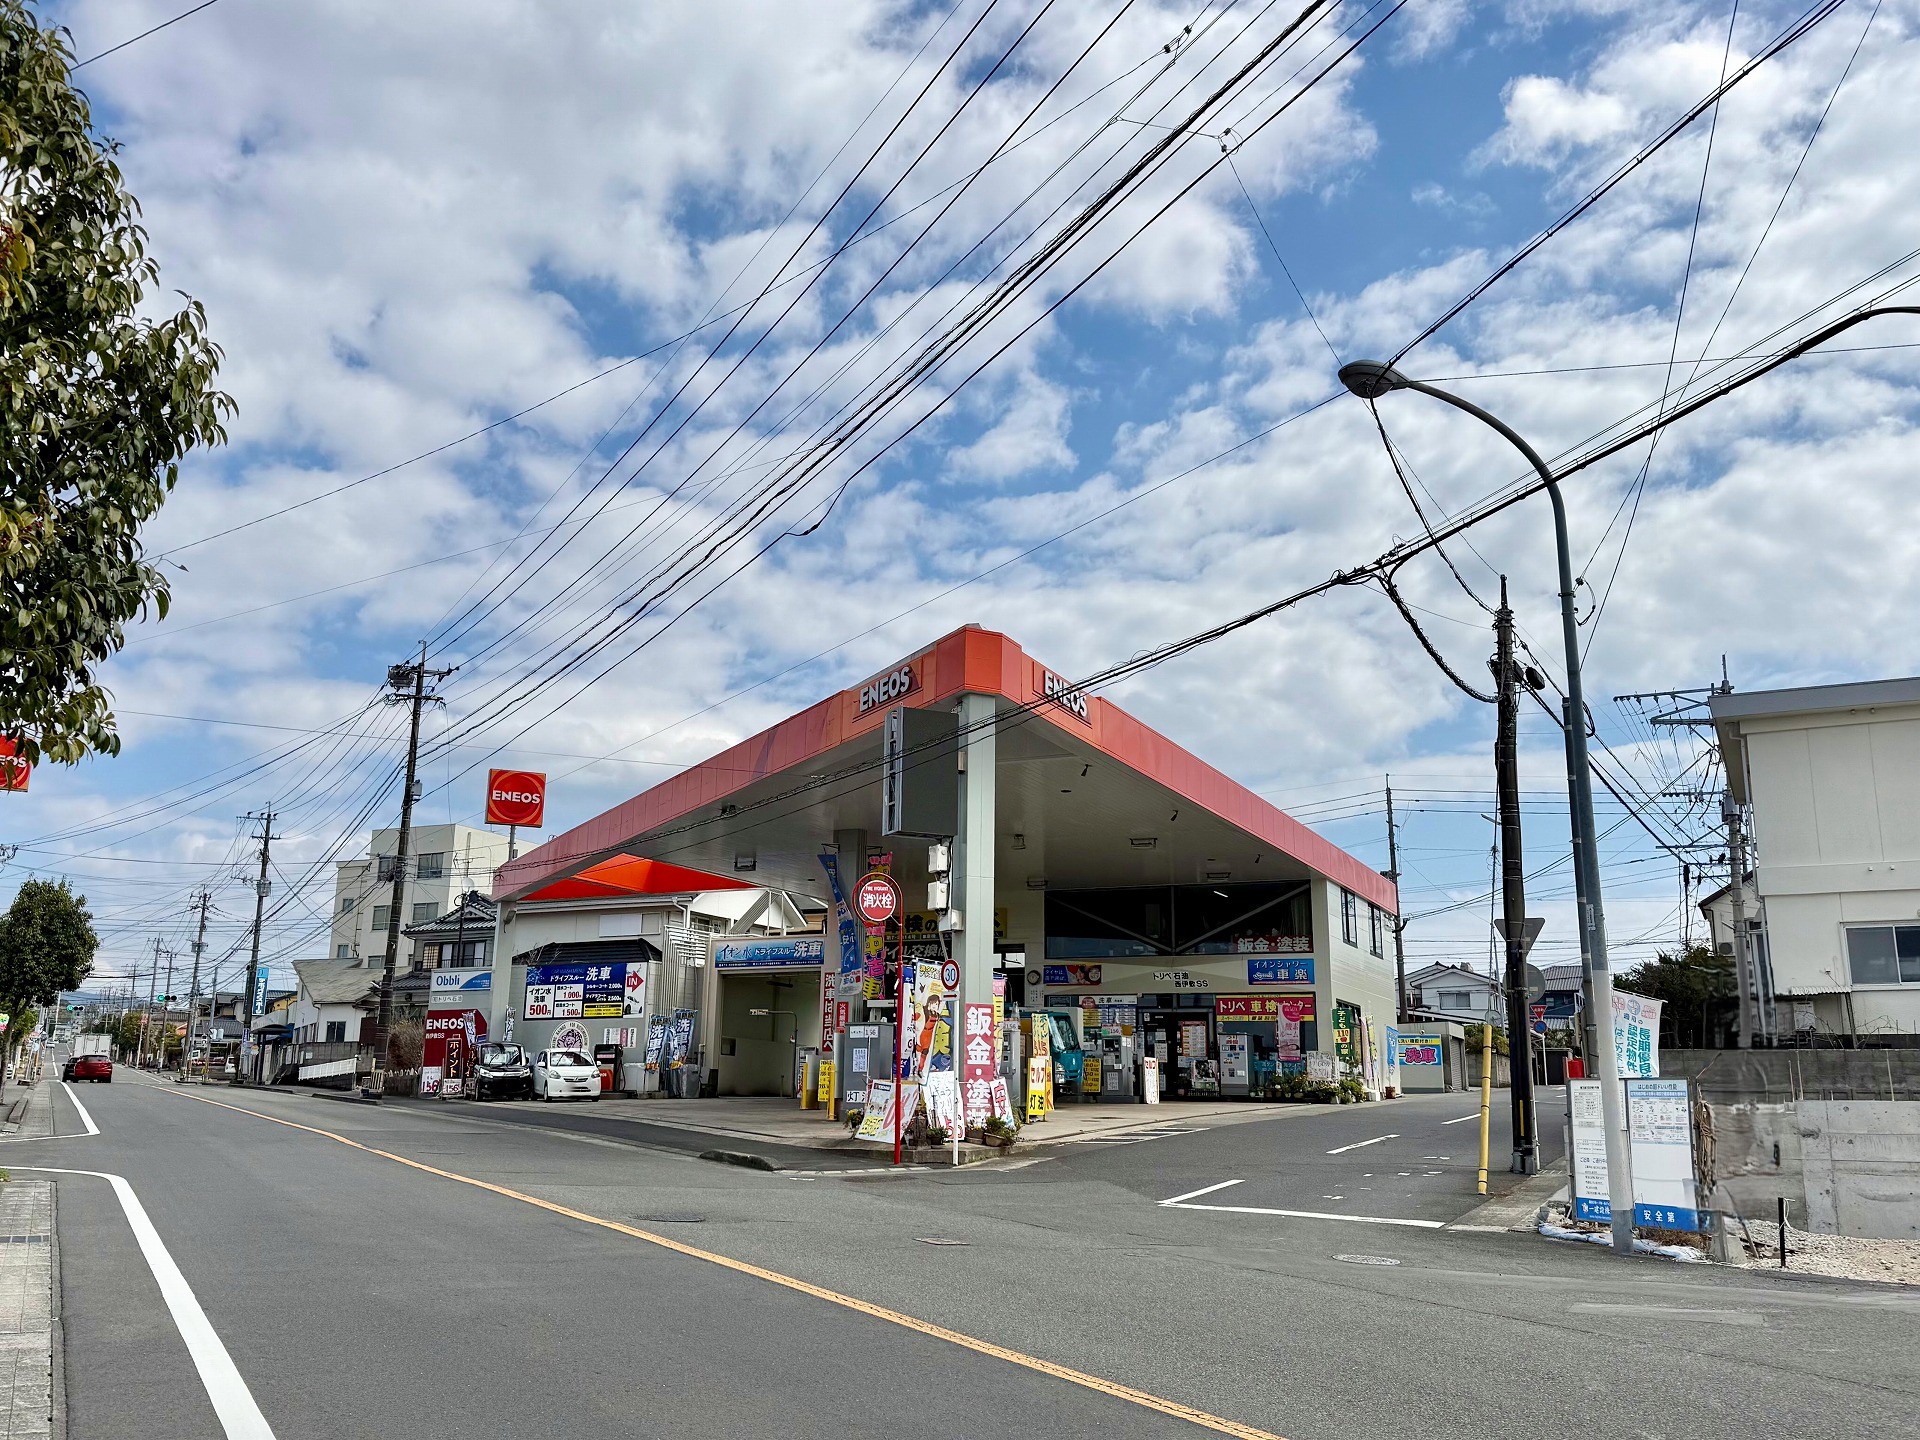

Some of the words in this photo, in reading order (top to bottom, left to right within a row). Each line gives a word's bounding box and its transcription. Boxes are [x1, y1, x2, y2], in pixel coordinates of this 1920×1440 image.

[859, 665, 911, 713] ENEOS
[1043, 669, 1089, 718] ENEOS
[491, 789, 541, 804] ENEOS
[863, 893, 892, 908] 消火栓
[755, 947, 795, 956] ドライブスルー
[794, 941, 823, 958] 洗車
[1237, 936, 1310, 953] 鈑金・塗装
[1254, 961, 1307, 969] イオンシャワー
[436, 974, 460, 986] Obbli
[585, 966, 612, 981] 洗車
[945, 968, 956, 982] 30
[1277, 969, 1308, 980] 車楽
[628, 977, 638, 986] IN
[529, 988, 552, 996] イオン水
[529, 1004, 551, 1016] 500円
[426, 1018, 464, 1030] ENEOS
[1030, 1093, 1045, 1111] 灯油
[1643, 1210, 1675, 1223] 安全第
